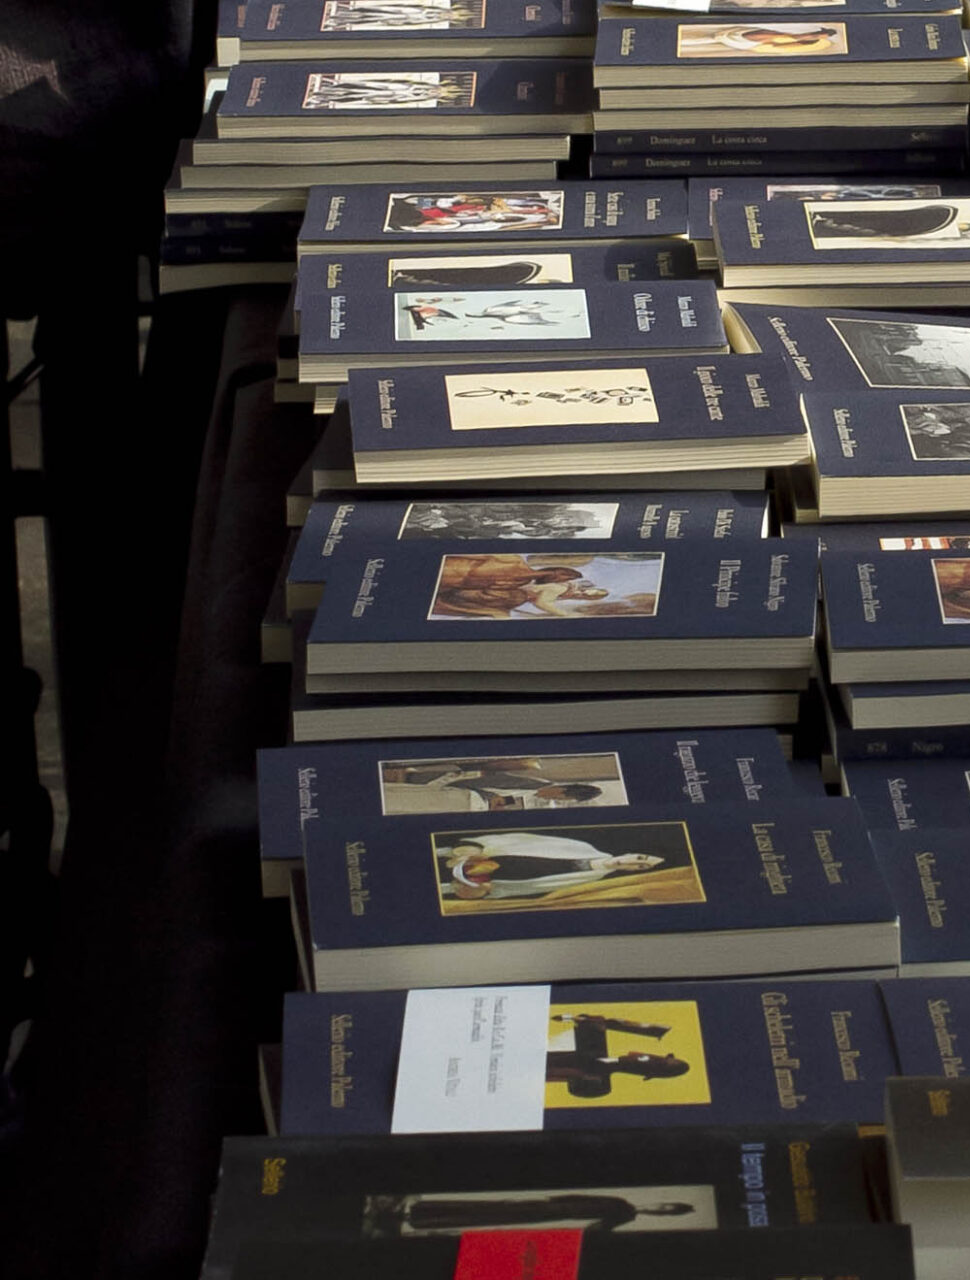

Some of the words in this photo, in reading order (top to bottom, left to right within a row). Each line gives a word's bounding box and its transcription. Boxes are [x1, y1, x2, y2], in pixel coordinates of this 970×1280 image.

[743, 205, 758, 221] Sellerio
[748, 234, 765, 249] Palermo
[329, 296, 345, 308] Sellerio
[631, 293, 652, 309] Odore
[676, 296, 693, 309] Marco
[328, 309, 345, 323] editore
[635, 316, 655, 332] chiuso
[679, 309, 697, 327] Malvaldi
[765, 316, 794, 336] Sellerio
[328, 323, 345, 339] Palermo
[780, 336, 804, 356] editore
[690, 371, 718, 383] gioco
[790, 356, 816, 381] Palermo
[743, 374, 763, 387] Marco
[700, 384, 725, 398] delle
[746, 388, 771, 408] Malvaldi
[706, 406, 727, 421] carte
[334, 504, 359, 518] Sellerio
[321, 535, 345, 556] Palermo
[364, 558, 386, 578] Sellerio
[712, 566, 741, 589] Principe
[856, 563, 874, 580] Sellerio
[358, 579, 379, 596] editore
[859, 581, 878, 599] editore
[351, 596, 375, 617] Palermo
[715, 590, 740, 608] fulvo
[862, 600, 882, 622] Palermo
[295, 768, 317, 787] Sellerio
[297, 788, 318, 807] editore
[750, 823, 775, 833] La
[344, 841, 365, 865] Sellerio
[755, 836, 778, 852] casa
[811, 830, 838, 861] Francesco
[913, 852, 936, 877] Sellerio
[345, 867, 367, 890] editore
[757, 862, 794, 895] ringhiera
[918, 878, 942, 899] editore
[346, 891, 369, 916] Palermo
[922, 900, 947, 928] Palermo
[761, 992, 790, 1004] Gli
[329, 1014, 352, 1042] Sellerio
[763, 1006, 797, 1045] scheletri
[831, 1011, 854, 1050] Francesco
[330, 1044, 352, 1074] editore
[836, 1051, 861, 1081] Recami
[330, 1076, 351, 1108] Palermo
[926, 1089, 952, 1116] Sellerio
[261, 1158, 288, 1195] Sellerio
[740, 1153, 766, 1189] tempo
[742, 1203, 771, 1227] posa
